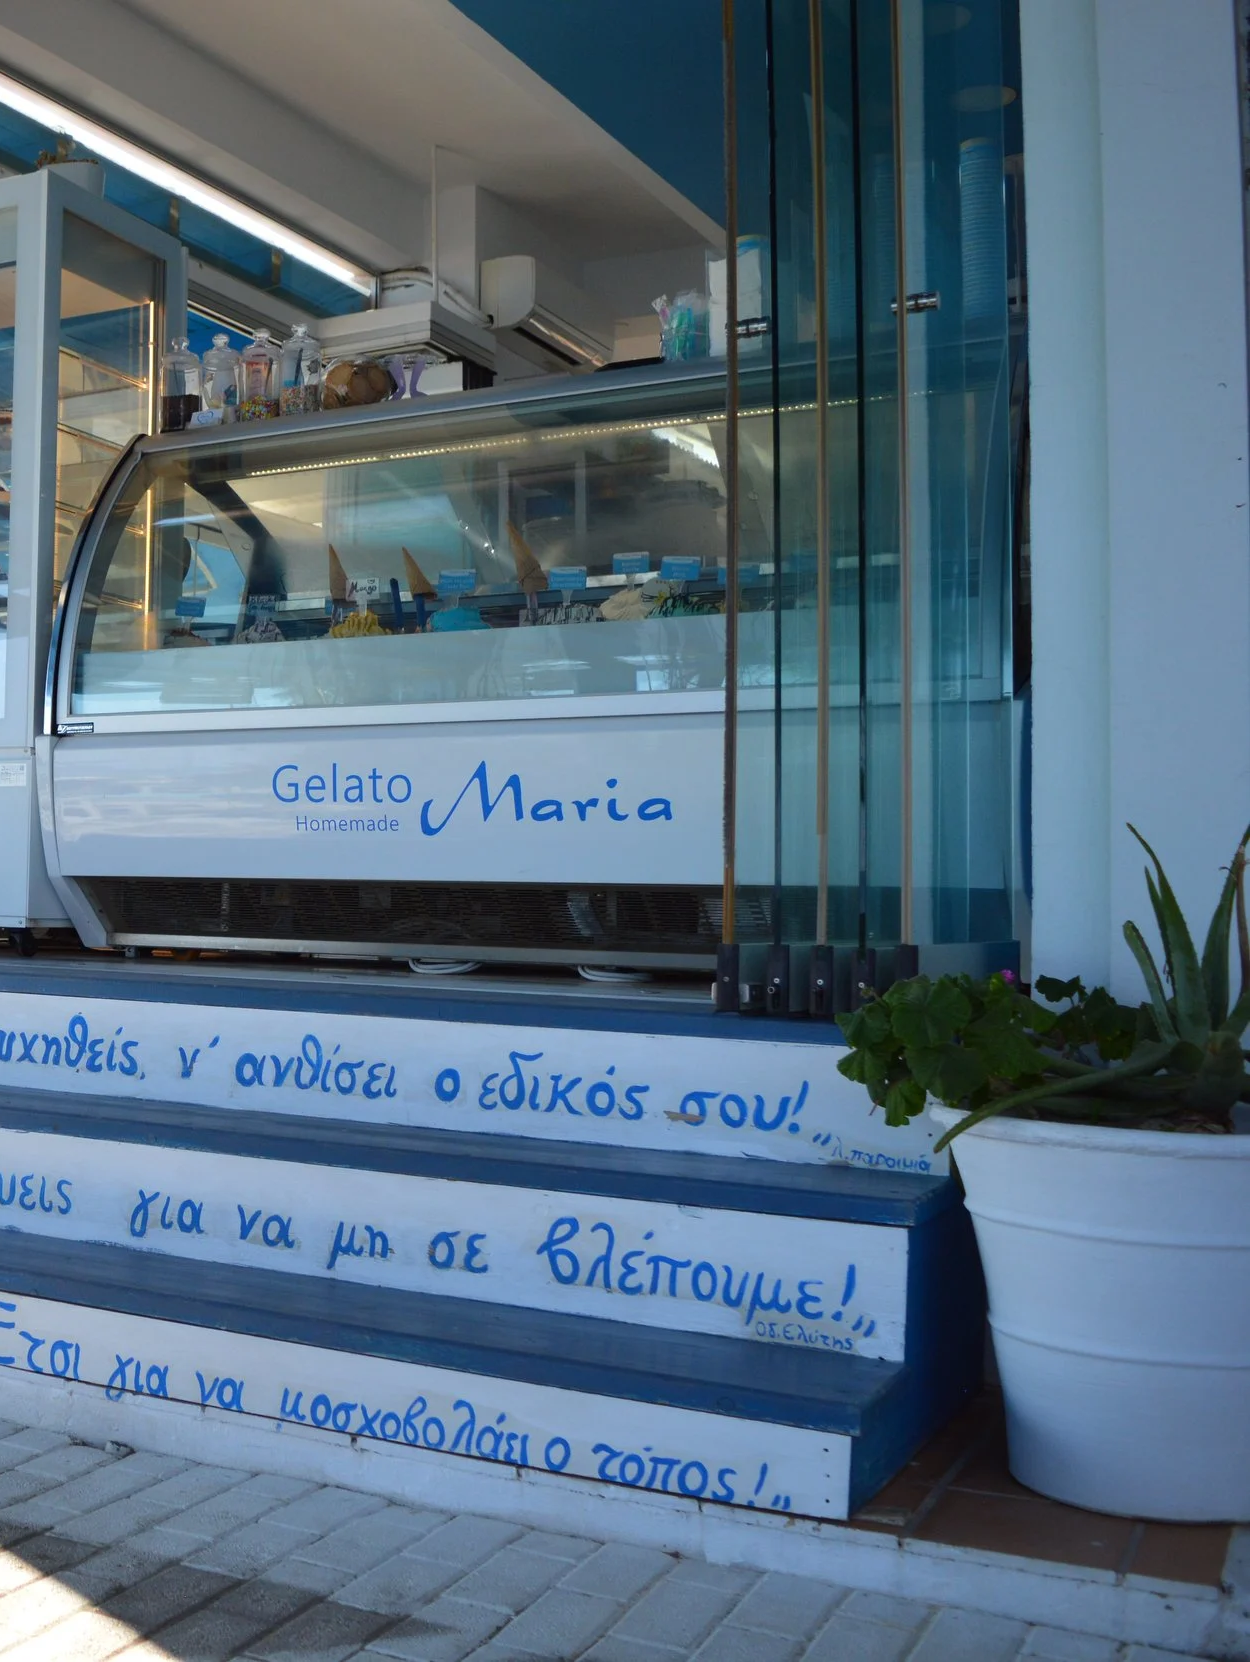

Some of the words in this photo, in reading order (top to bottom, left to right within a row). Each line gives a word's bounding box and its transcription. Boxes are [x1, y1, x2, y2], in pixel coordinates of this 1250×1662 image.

[272, 763, 412, 804] Gelato
[420, 760, 672, 836] Maria
[295, 814, 399, 832] Homemade
[235, 1034, 397, 1100] ανθίσει
[435, 1068, 461, 1102] ο
[478, 1051, 650, 1121] εδικός
[130, 1189, 204, 1238] για
[237, 1204, 296, 1249] να
[326, 1221, 391, 1270] μη
[429, 1230, 489, 1273] σε
[105, 1354, 169, 1400] για
[196, 1370, 245, 1413] να
[275, 1387, 530, 1467] μοσχοβολάει
[544, 1436, 571, 1472] ο
